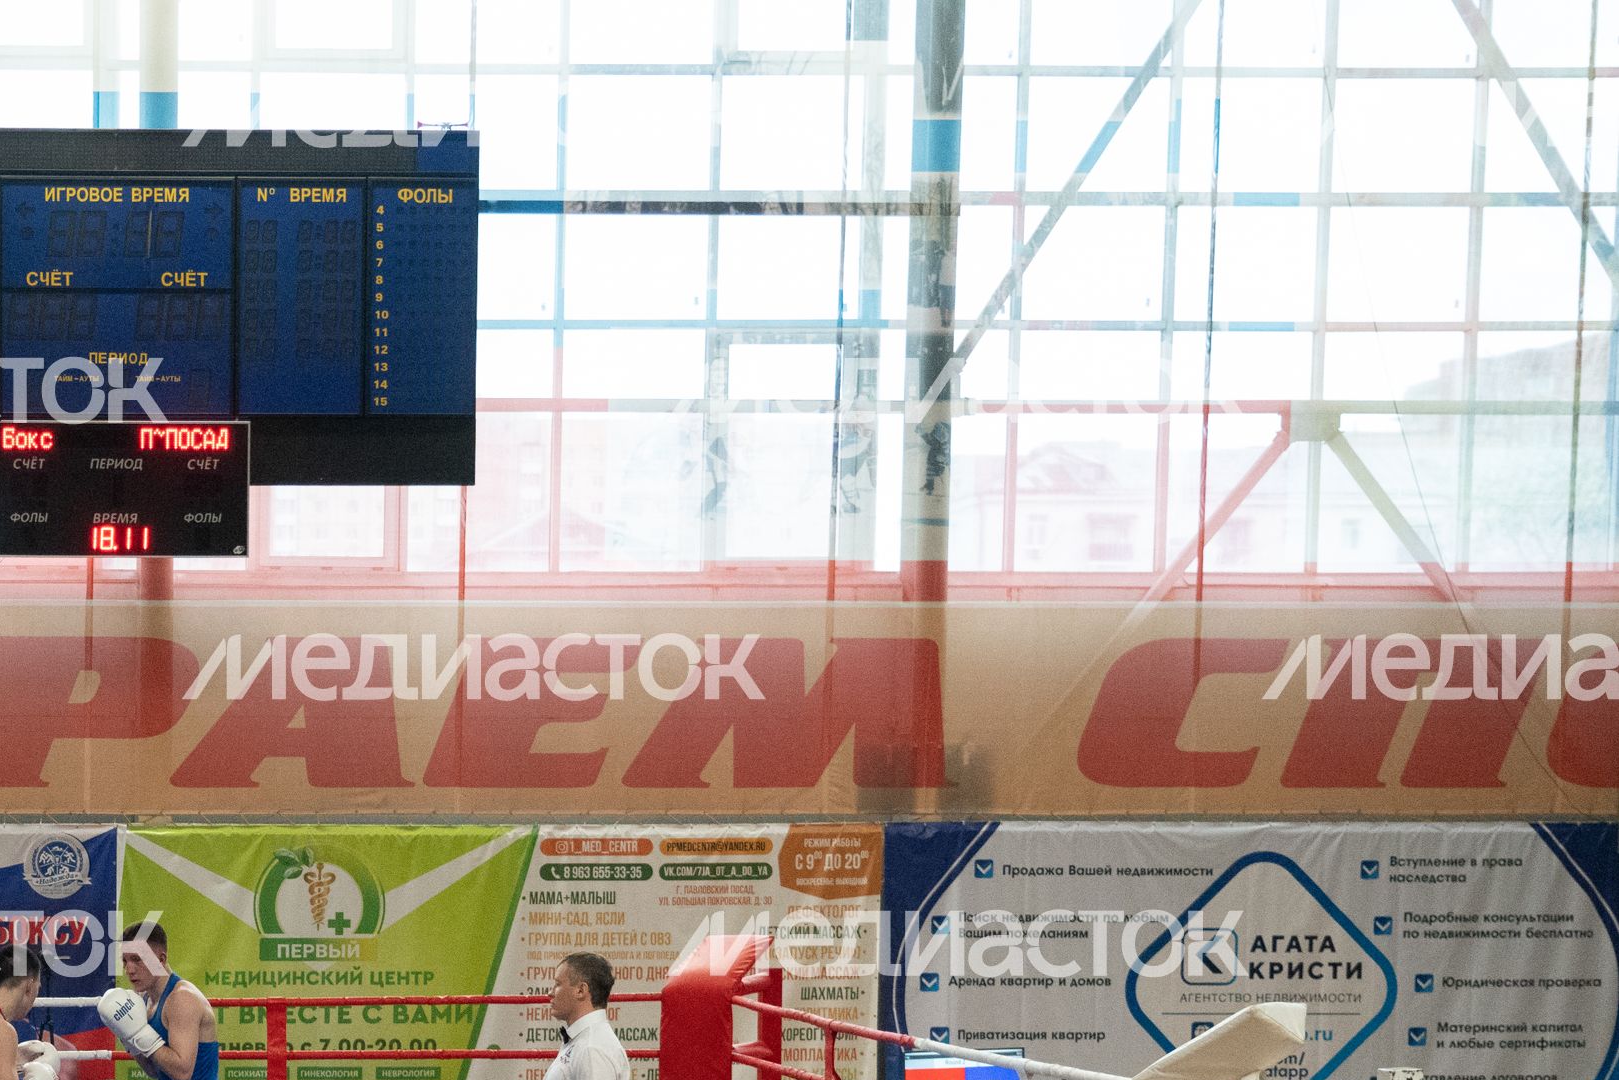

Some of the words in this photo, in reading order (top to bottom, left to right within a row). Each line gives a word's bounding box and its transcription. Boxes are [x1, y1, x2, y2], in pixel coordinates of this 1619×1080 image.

[45, 187, 122, 202] ИГРОВОЕ
[132, 188, 190, 202] ВРЕМЯ
[290, 188, 347, 202] ВРЕМЯ
[398, 189, 453, 203] ФОЛЫ
[377, 206, 384, 214] 4
[376, 223, 383, 232] 5
[376, 241, 383, 249] 6
[376, 258, 383, 266] 7
[26, 269, 73, 286] СЧЁТ
[161, 270, 208, 286] СЧЁТ
[376, 276, 383, 284] 8
[376, 293, 383, 301] 9
[375, 311, 389, 319] 10
[375, 328, 388, 336] 11
[375, 346, 388, 354] 12
[89, 353, 148, 365] ПЕРИОД
[375, 363, 388, 371] 13
[374, 380, 388, 388] 14
[374, 398, 387, 406] 15
[2, 428, 53, 449] Бокс
[13, 457, 45, 470] СЧЁТ
[90, 458, 143, 471] ПЕРИОД
[187, 458, 220, 470] СЧЁТ
[10, 513, 48, 523] ФОЛЫ
[93, 513, 138, 523] ВРЕМЯ
[184, 513, 222, 523] ФОЛЫ
[1077, 637, 1619, 790] СП
[1390, 856, 1465, 868] Вступление
[1471, 858, 1477, 866] в
[1482, 858, 1523, 868] права
[564, 867, 570, 878] 8
[573, 867, 590, 878] 963
[593, 867, 642, 878] 655-33-35
[1003, 865, 1064, 877] Продажа
[1069, 865, 1112, 876] Вашей
[1116, 867, 1213, 878] недвижимости
[1390, 874, 1467, 884] наследства
[684, 885, 729, 894] ПАВЛОВСКИЙ
[529, 891, 616, 905] МАМА+МАЛЫШ
[672, 897, 707, 906] БОЛЬШАЯ
[788, 905, 861, 919] ДЕФЕКТОЛОГ
[1003, 913, 1098, 924] недвижимости
[1104, 914, 1119, 923] по
[1125, 912, 1169, 923] любым
[1403, 912, 1479, 924] Подробные
[1484, 914, 1574, 924] консультации
[596, 912, 625, 925] ЯСЛИ
[813, 925, 861, 939] МАССАЖ
[959, 929, 1002, 939] Вашим
[1007, 929, 1089, 940] пожеланиям
[1403, 930, 1419, 938] по
[1424, 930, 1521, 940] недвижимости
[1526, 928, 1594, 938] бесплатно
[529, 932, 571, 946] ГРУППА
[574, 933, 599, 947] ДЛЯ
[602, 931, 637, 947] ДЕТЕЙ
[641, 933, 648, 945] С
[1250, 935, 1336, 953] АГАТА
[277, 941, 360, 959] ПЕРВЫЙ
[1249, 962, 1362, 980] КРИСТИ
[205, 966, 362, 989] МЕДИЦИНСКИЙ
[370, 971, 434, 988] ЦЕНТР
[948, 976, 996, 988] Аренда
[1000, 976, 1054, 988] квартир
[1059, 977, 1067, 986] и
[1070, 977, 1111, 987] домов
[1442, 977, 1535, 988] Юридическая
[1538, 978, 1602, 990] проверка
[801, 987, 859, 1000] ШАХМАТЫ
[1180, 993, 1251, 1003] АГЕНТСТВО
[1256, 994, 1362, 1004] НЕДВИЖИМОСТИ
[362, 1005, 381, 1024] С
[393, 1004, 473, 1024] ВАМИ
[1437, 1022, 1527, 1034] Материнский
[1531, 1024, 1583, 1033] капитал
[958, 1029, 1047, 1042] Приватизация
[1052, 1031, 1106, 1043] квартир
[1437, 1040, 1444, 1048] и
[1449, 1038, 1494, 1048] любые
[1499, 1038, 1586, 1050] сертификаты
[300, 1068, 359, 1079] ГИНЕКОЛОГИЯ
[382, 1068, 435, 1078] НЕВРОЛОГИЯ
